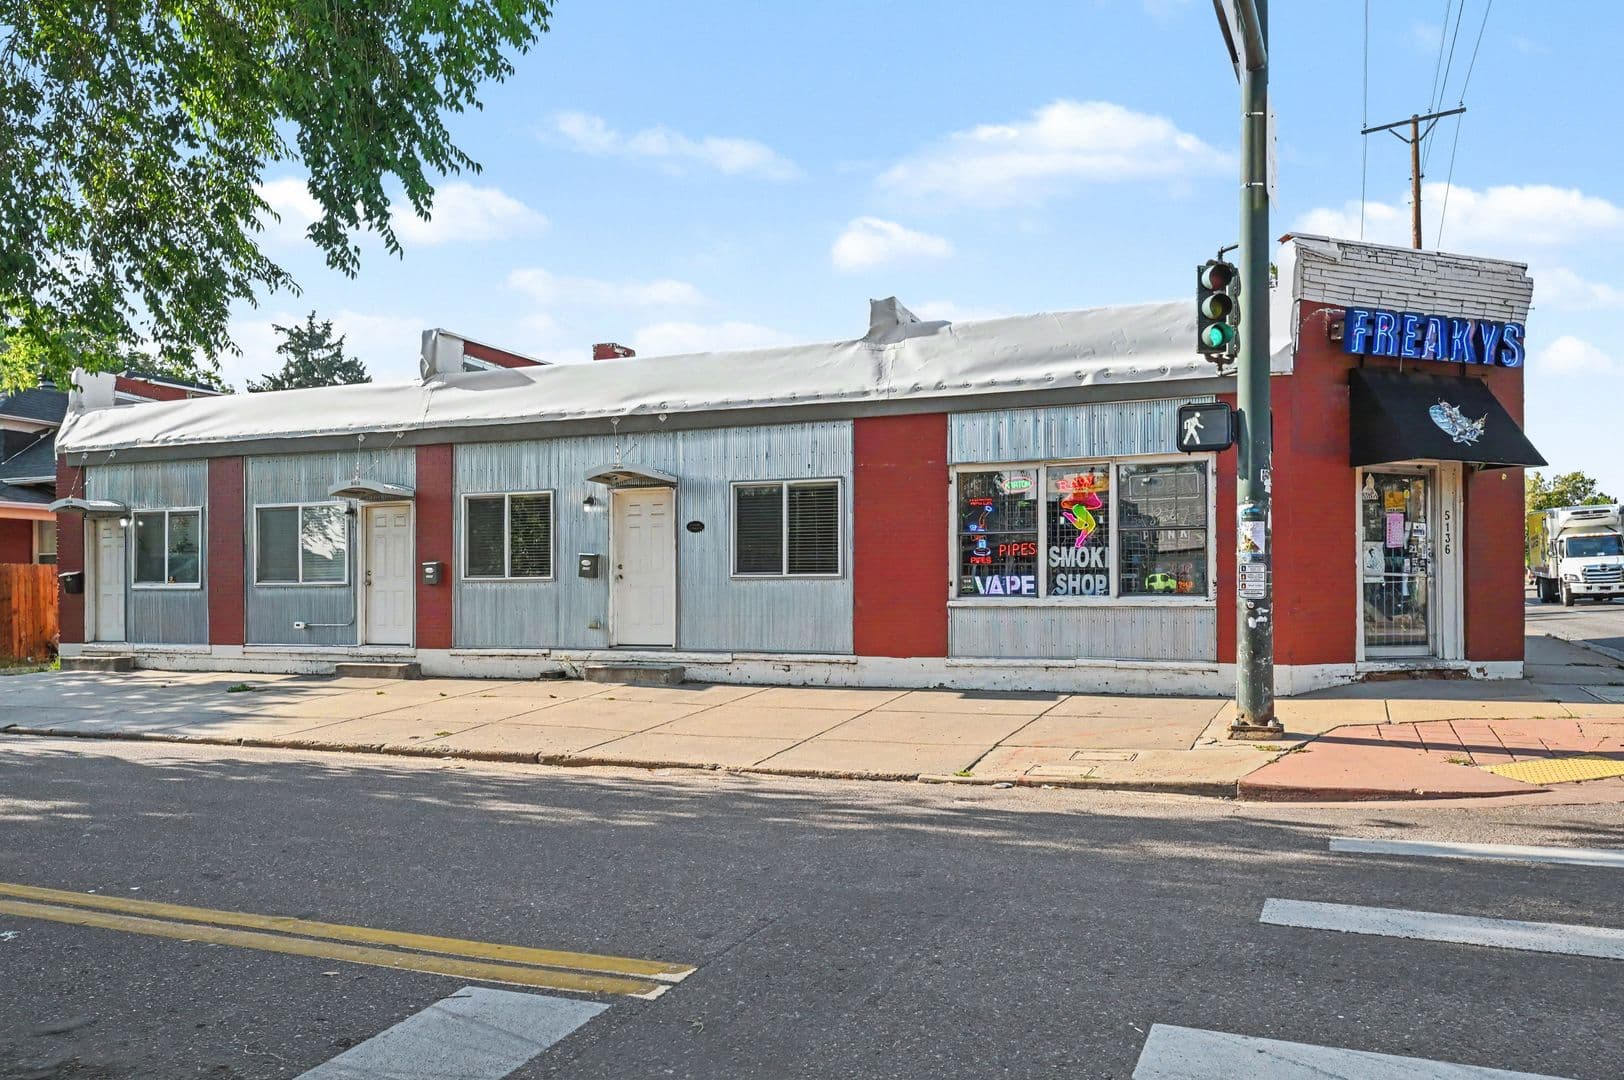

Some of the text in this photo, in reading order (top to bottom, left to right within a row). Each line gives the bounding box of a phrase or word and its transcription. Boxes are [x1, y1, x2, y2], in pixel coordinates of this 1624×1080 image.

[1345, 307, 1525, 368] FREAKYS
[999, 542, 1037, 556] PIPES
[974, 575, 1035, 595] VAPE
[1055, 573, 1107, 595] SHOP
